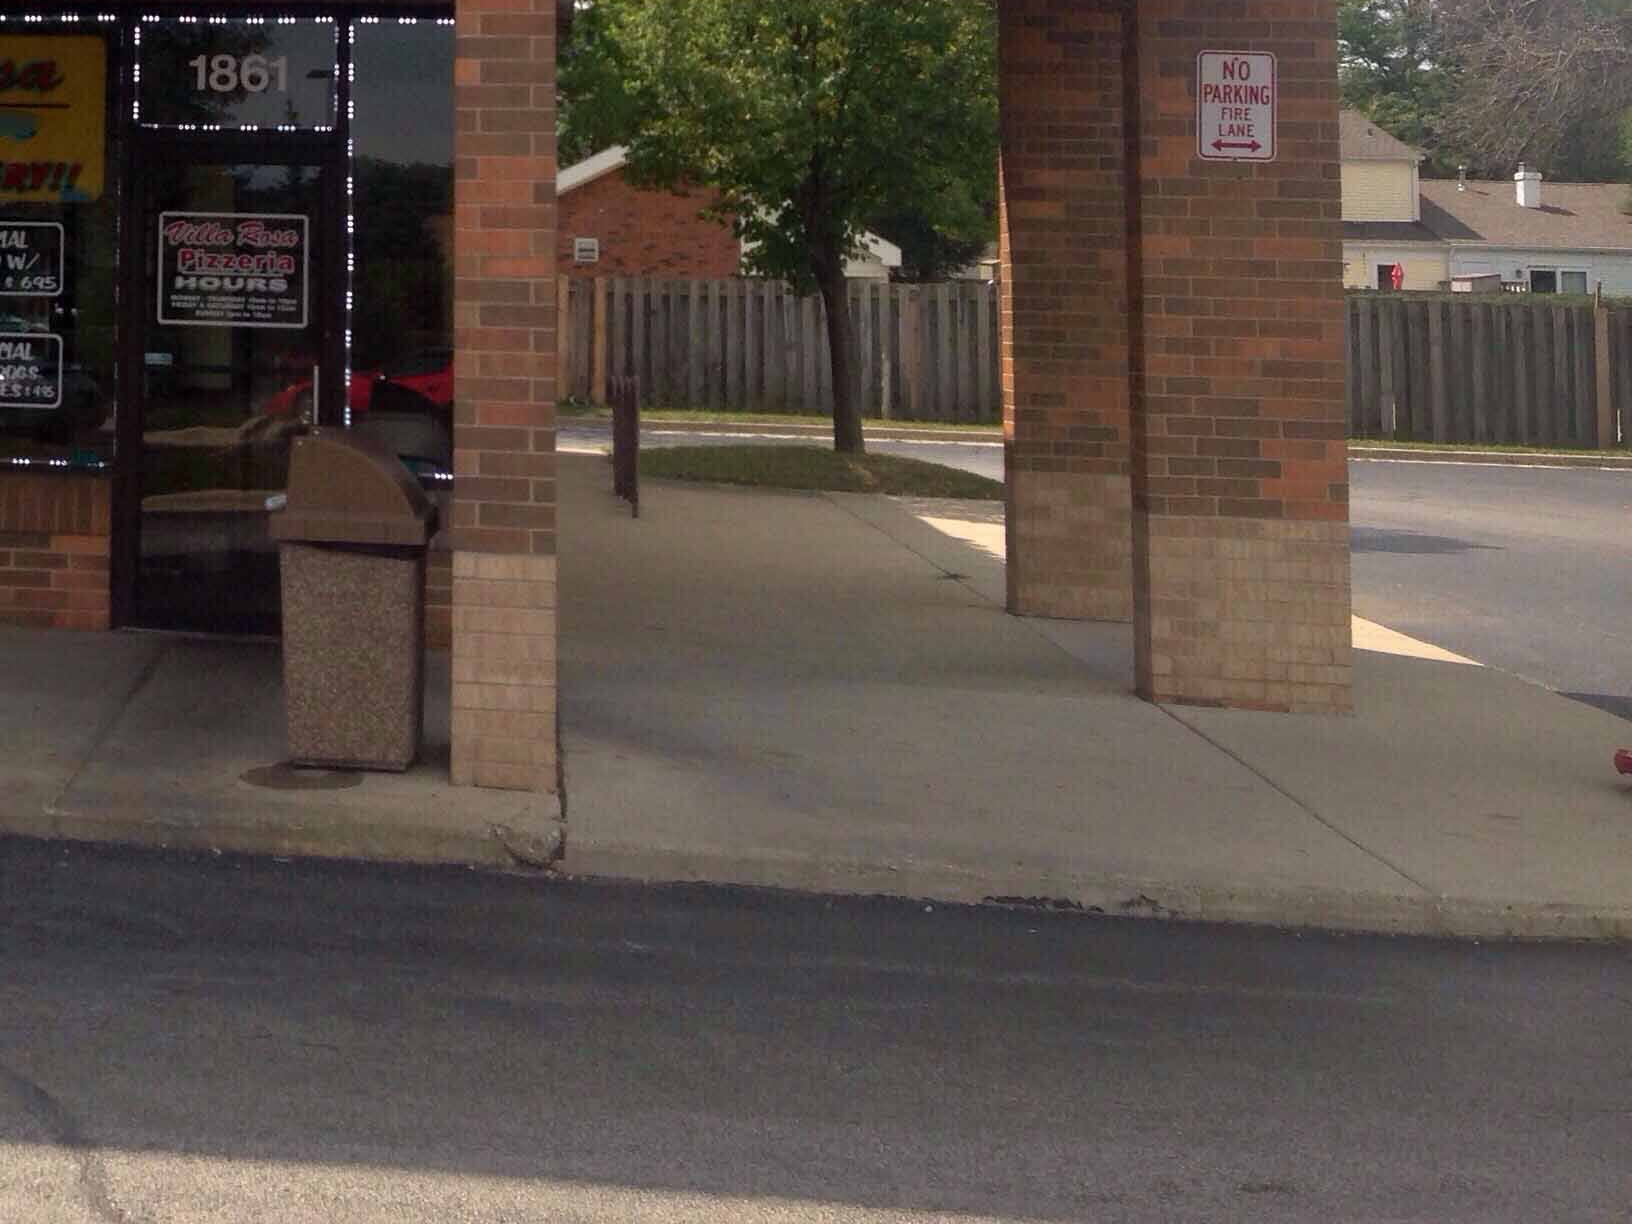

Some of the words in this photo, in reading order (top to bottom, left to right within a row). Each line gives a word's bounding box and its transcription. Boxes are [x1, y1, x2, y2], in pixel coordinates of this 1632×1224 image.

[189, 53, 288, 93] 1861
[1222, 61, 1251, 81] NO
[1202, 83, 1271, 105] PARKING
[1221, 107, 1253, 122] FIRE
[1218, 123, 1256, 138] LANE
[165, 219, 235, 246] Villa
[236, 220, 300, 248] Rosa
[178, 248, 295, 274] Pizzeria
[174, 275, 289, 294] HOURS
